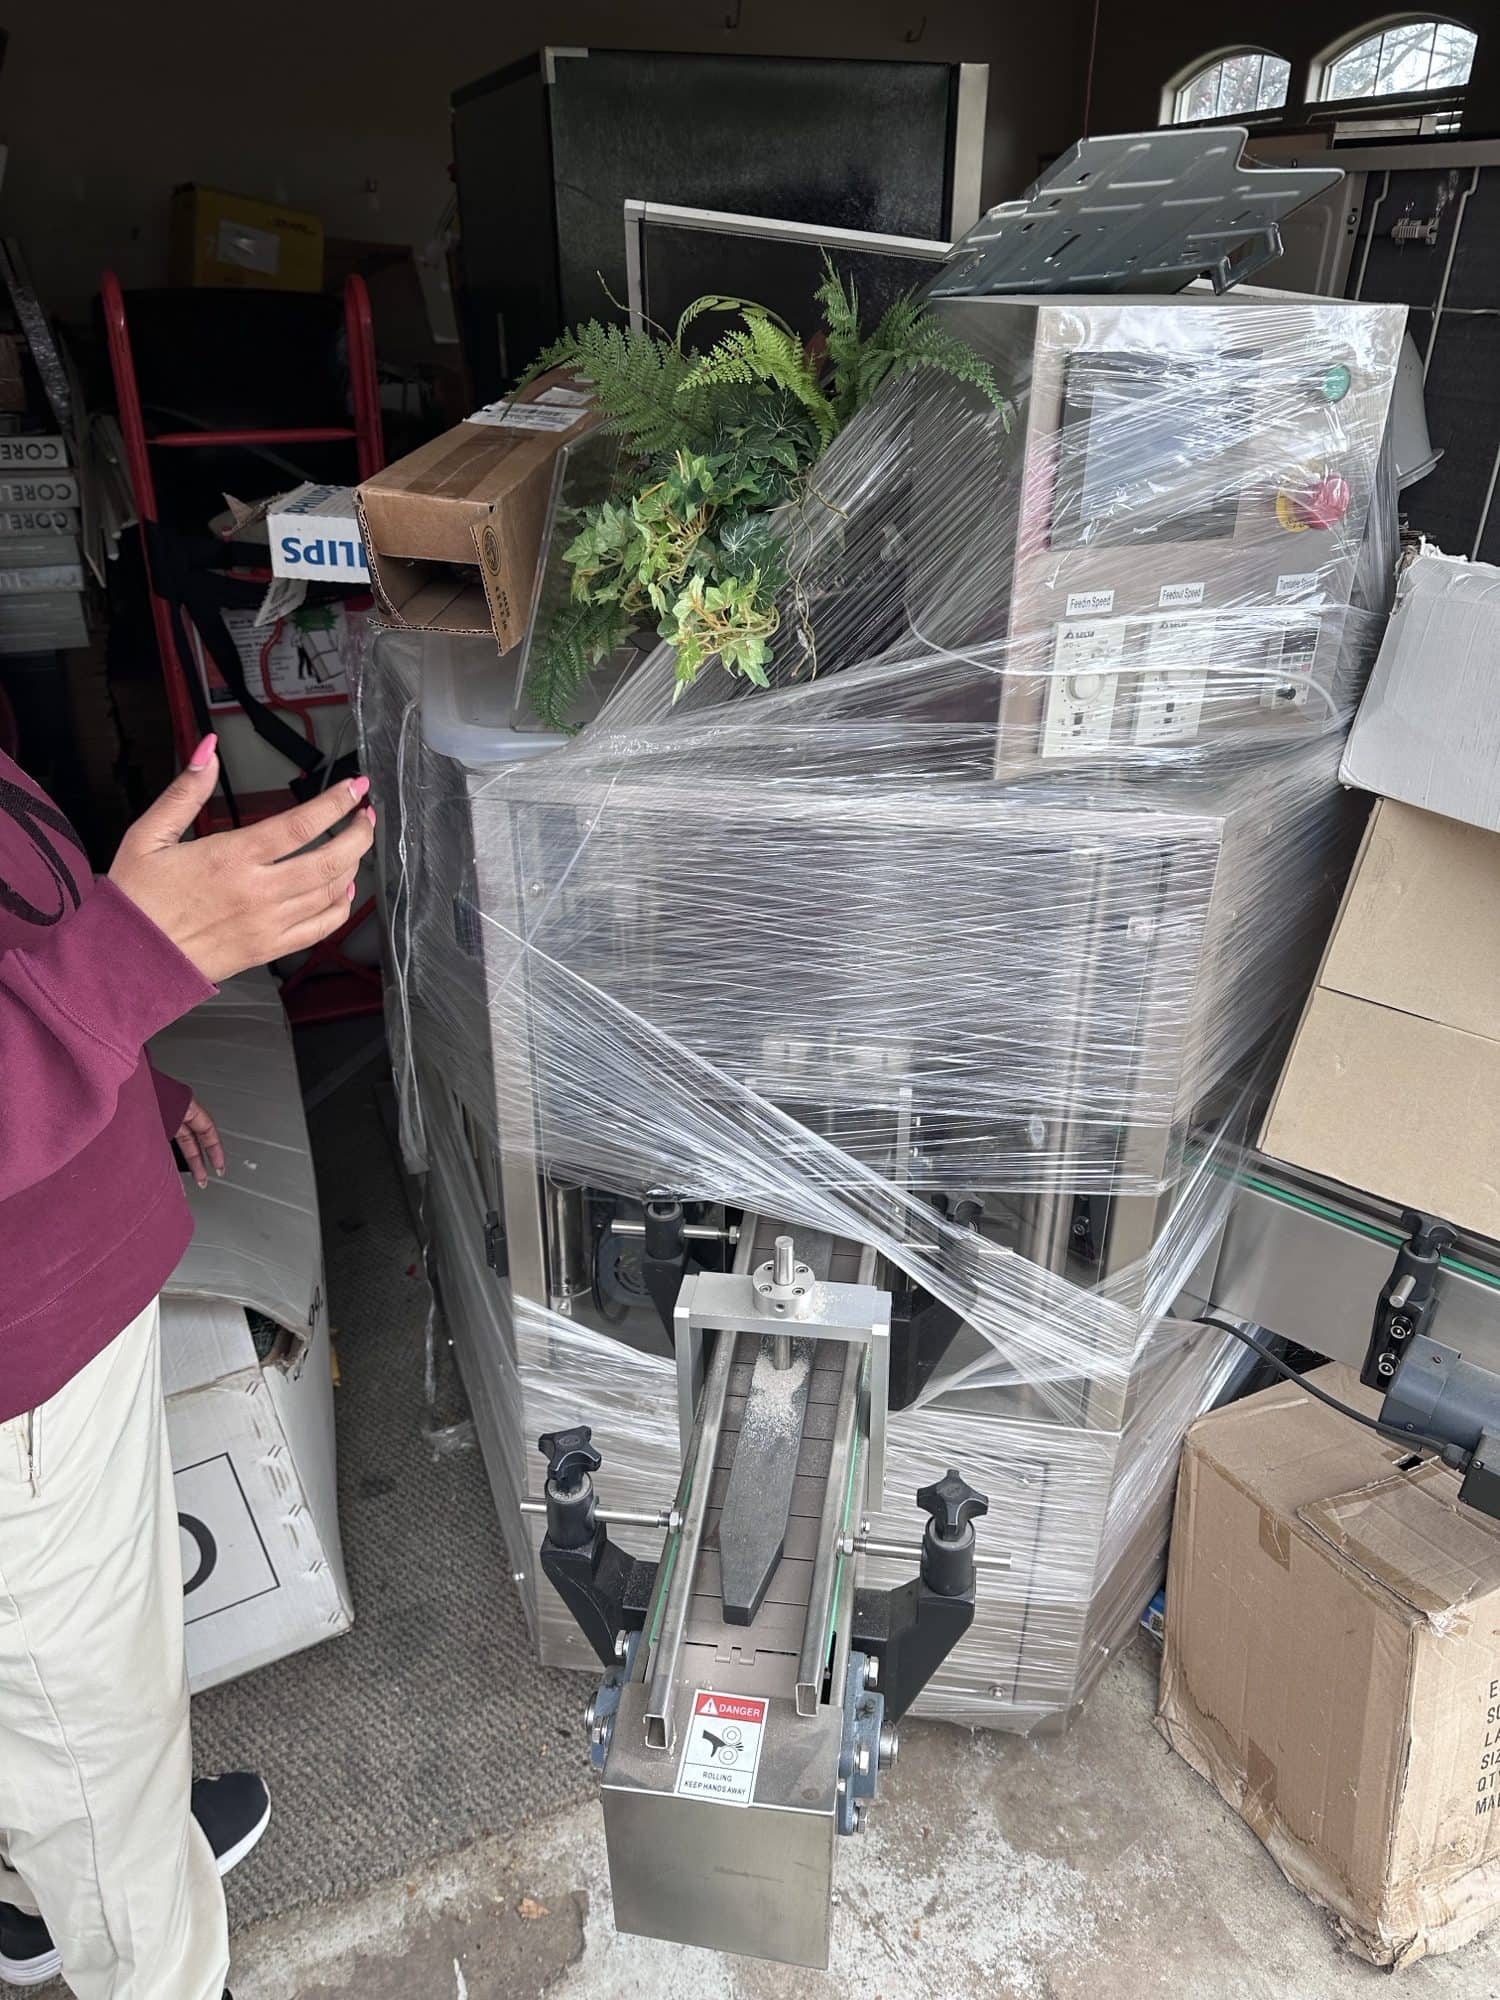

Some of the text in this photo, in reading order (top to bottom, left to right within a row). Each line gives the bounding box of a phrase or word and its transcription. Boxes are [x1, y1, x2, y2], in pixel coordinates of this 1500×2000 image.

[281, 536, 369, 568] ILIPS
[1091, 595, 1111, 607] Speed
[719, 1703, 761, 1718] DANGER
[702, 1771, 733, 1783] ROLLING
[1477, 1770, 1500, 1794] QT
[684, 1780, 746, 1796] KEEP HANDS AWAY
